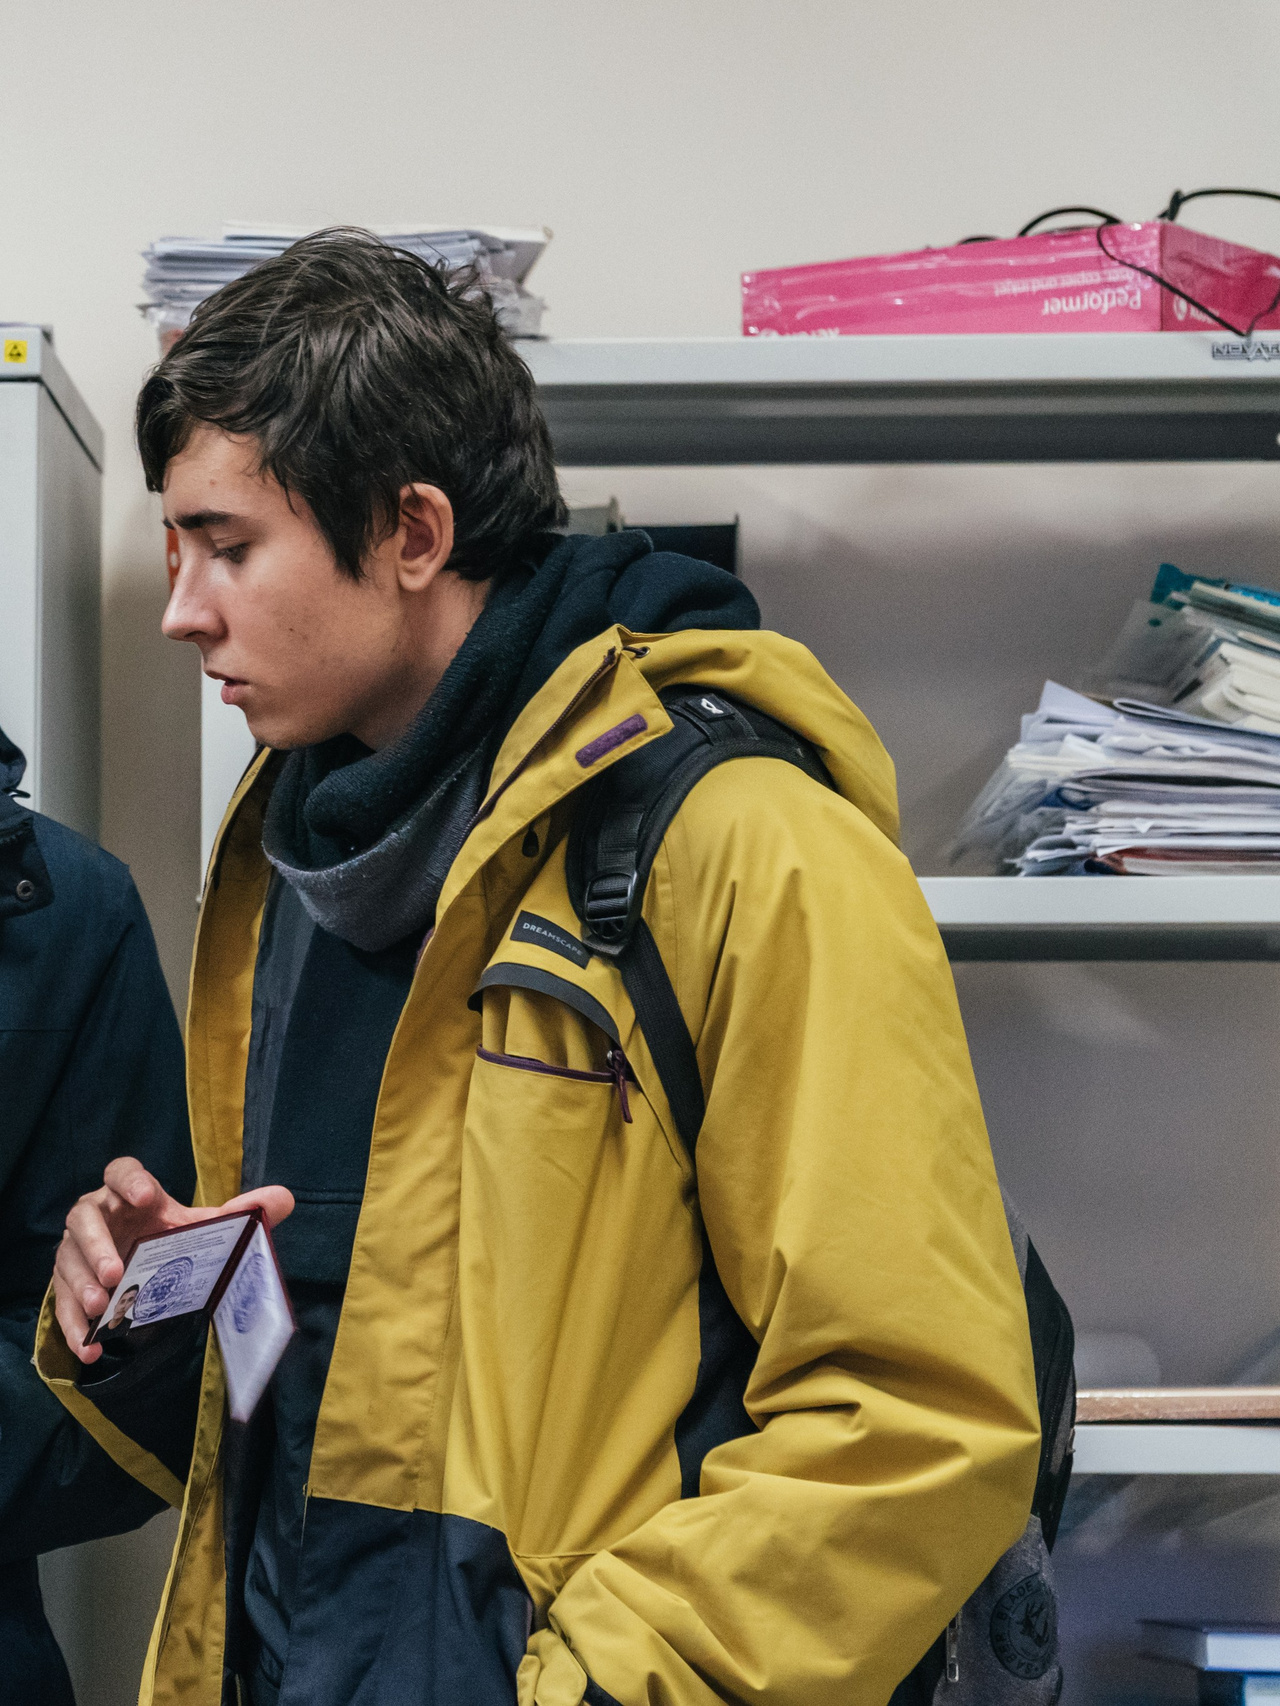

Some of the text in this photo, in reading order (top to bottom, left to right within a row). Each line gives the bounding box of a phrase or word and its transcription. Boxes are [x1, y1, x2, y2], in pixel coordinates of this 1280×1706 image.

[1042, 287, 1141, 315] Performer
[522, 922, 583, 956] DREAMSCAPE
[996, 1580, 1034, 1621] BLADE
